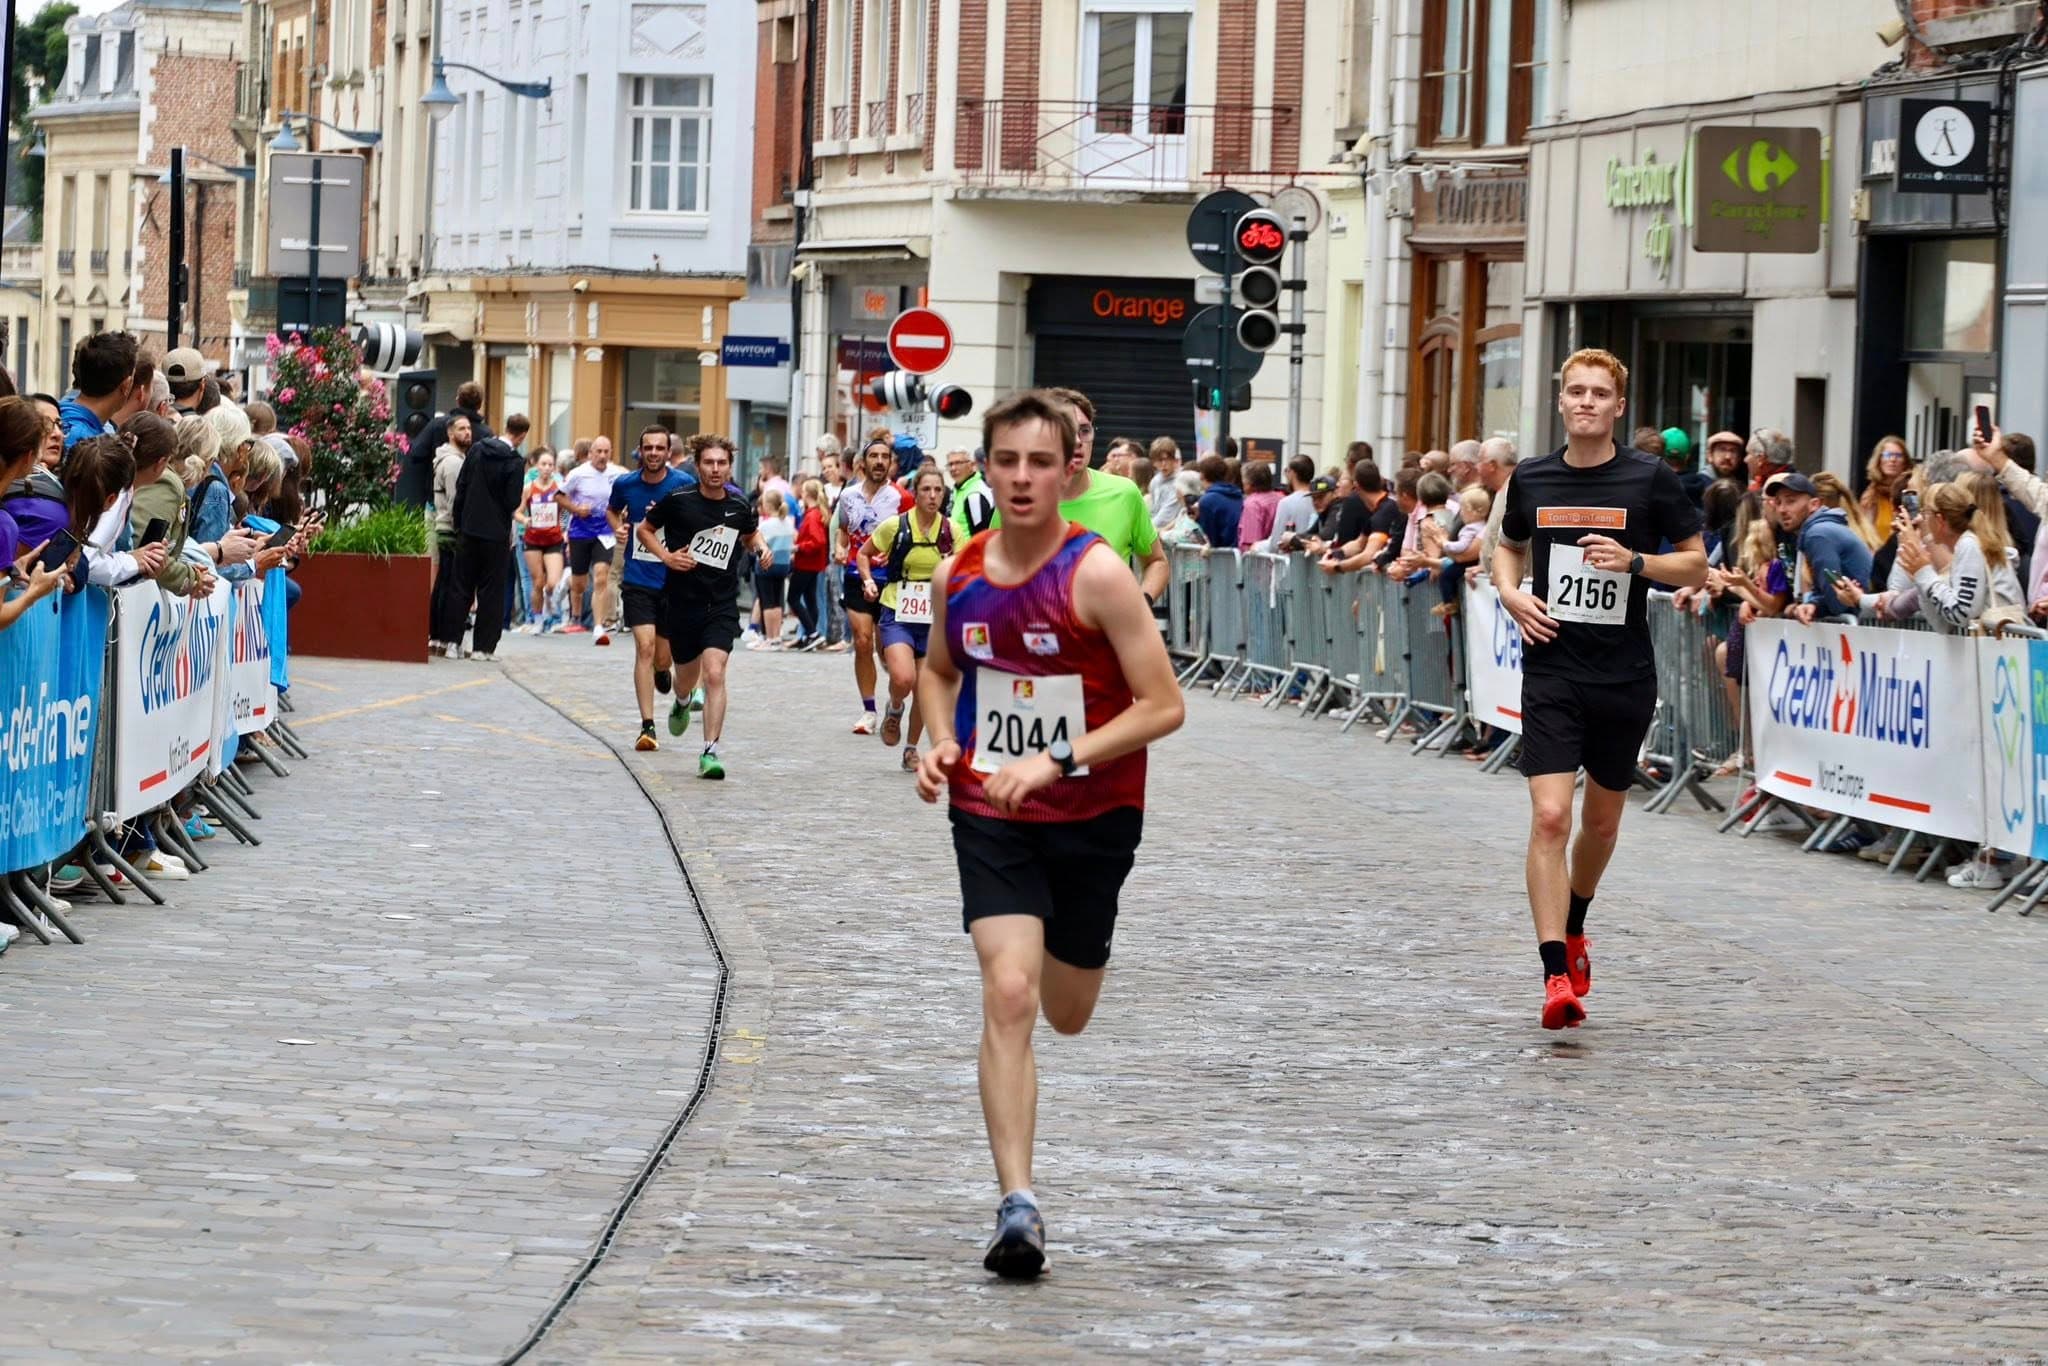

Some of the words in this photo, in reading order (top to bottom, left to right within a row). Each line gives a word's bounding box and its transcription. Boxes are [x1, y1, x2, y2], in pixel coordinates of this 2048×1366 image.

[1093, 288, 1185, 325] Orange
[901, 414, 926, 424] SAUF
[693, 535, 729, 561] 2209
[1557, 574, 1618, 610] 2156
[1768, 638, 1834, 731] Crédit
[1856, 650, 1932, 749] Mutuel
[987, 709, 1068, 757] 2044
